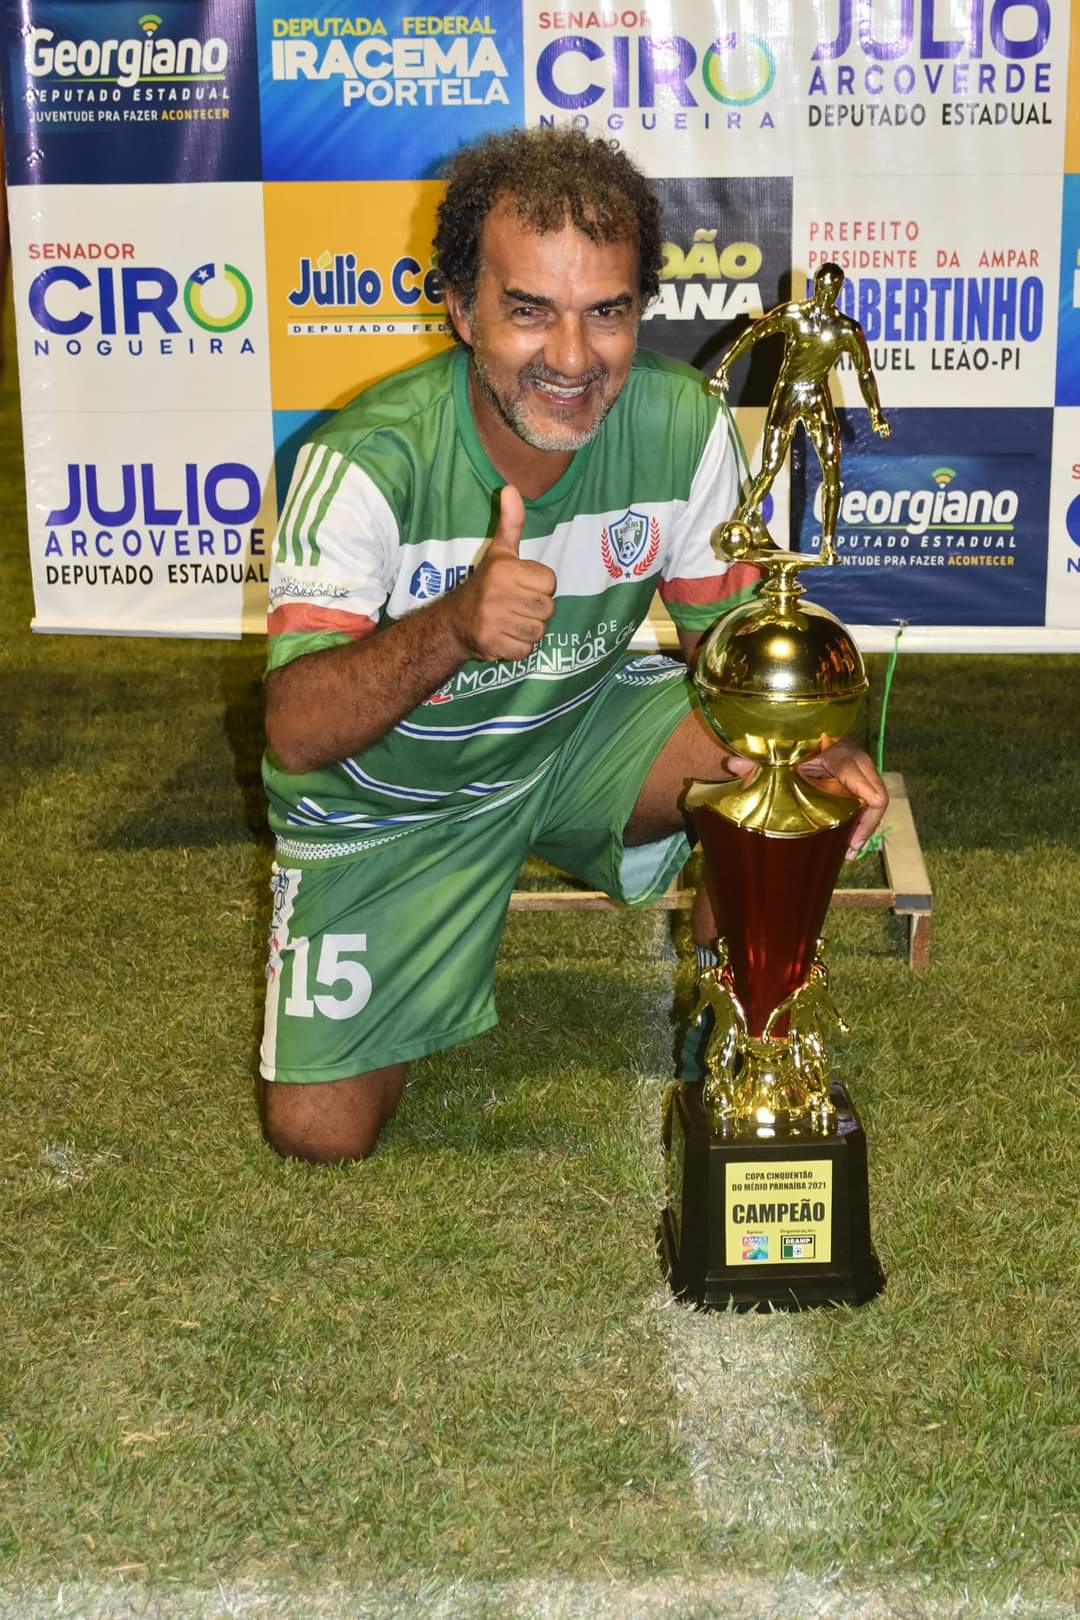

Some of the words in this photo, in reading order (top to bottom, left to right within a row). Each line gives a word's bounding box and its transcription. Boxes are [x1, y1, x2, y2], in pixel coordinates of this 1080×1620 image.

[273, 18, 387, 37] DEPUTADA
[403, 16, 496, 35] FEDERAL
[811, 0, 1051, 61] JULIO
[30, 28, 228, 87] Georgiano
[272, 37, 509, 80] IRACEMA
[536, 33, 776, 109] CIRO
[808, 63, 1052, 95] ARCOVERDE
[27, 89, 121, 102] EPUTADO
[133, 87, 230, 101] ESTADUAL
[343, 79, 509, 107] PORTELA
[98, 110, 120, 121] PRA
[123, 110, 158, 121] FAZER
[161, 108, 230, 121] ACONTECER
[539, 112, 775, 130] NOGUEIRA
[808, 103, 926, 127] DEPUTADO
[942, 102, 1052, 126] ESTADUAL
[809, 221, 919, 242] PREFEITO
[28, 243, 135, 260] SENADOR
[656, 228, 763, 280] OÃO
[808, 250, 917, 269] PRESIDENTE
[936, 250, 960, 269] DA
[979, 249, 1040, 268] AMPAR
[288, 250, 382, 306] Júlio
[28, 262, 254, 335] CIRO
[641, 283, 765, 320] ANA
[806, 276, 1044, 343] OBERTINHO
[293, 324, 396, 333] DEPUTADO
[34, 338, 256, 356] NOGUEIRA
[931, 342, 1021, 370] LEÃO-PI
[45, 463, 261, 527] JULIO
[45, 529, 266, 557] ARCOVERDE
[811, 536, 910, 548] DPUTADO
[921, 535, 1016, 548] ESTADUAL
[842, 555, 880, 567] NTUDE
[884, 555, 906, 566] PRA
[910, 555, 944, 566] FAZER
[948, 554, 1015, 566] ACONTECER
[46, 565, 153, 585] DEPUTADO
[168, 563, 268, 583] ESTADUAL
[597, 620, 617, 635] DE
[456, 637, 606, 690] MONSENHOR
[284, 933, 373, 1021] 15
[732, 1183, 742, 1191] DO
[808, 1181, 826, 1189] 2021
[745, 1171, 765, 1180] COPA
[732, 1199, 826, 1224] CAMPEÃO
